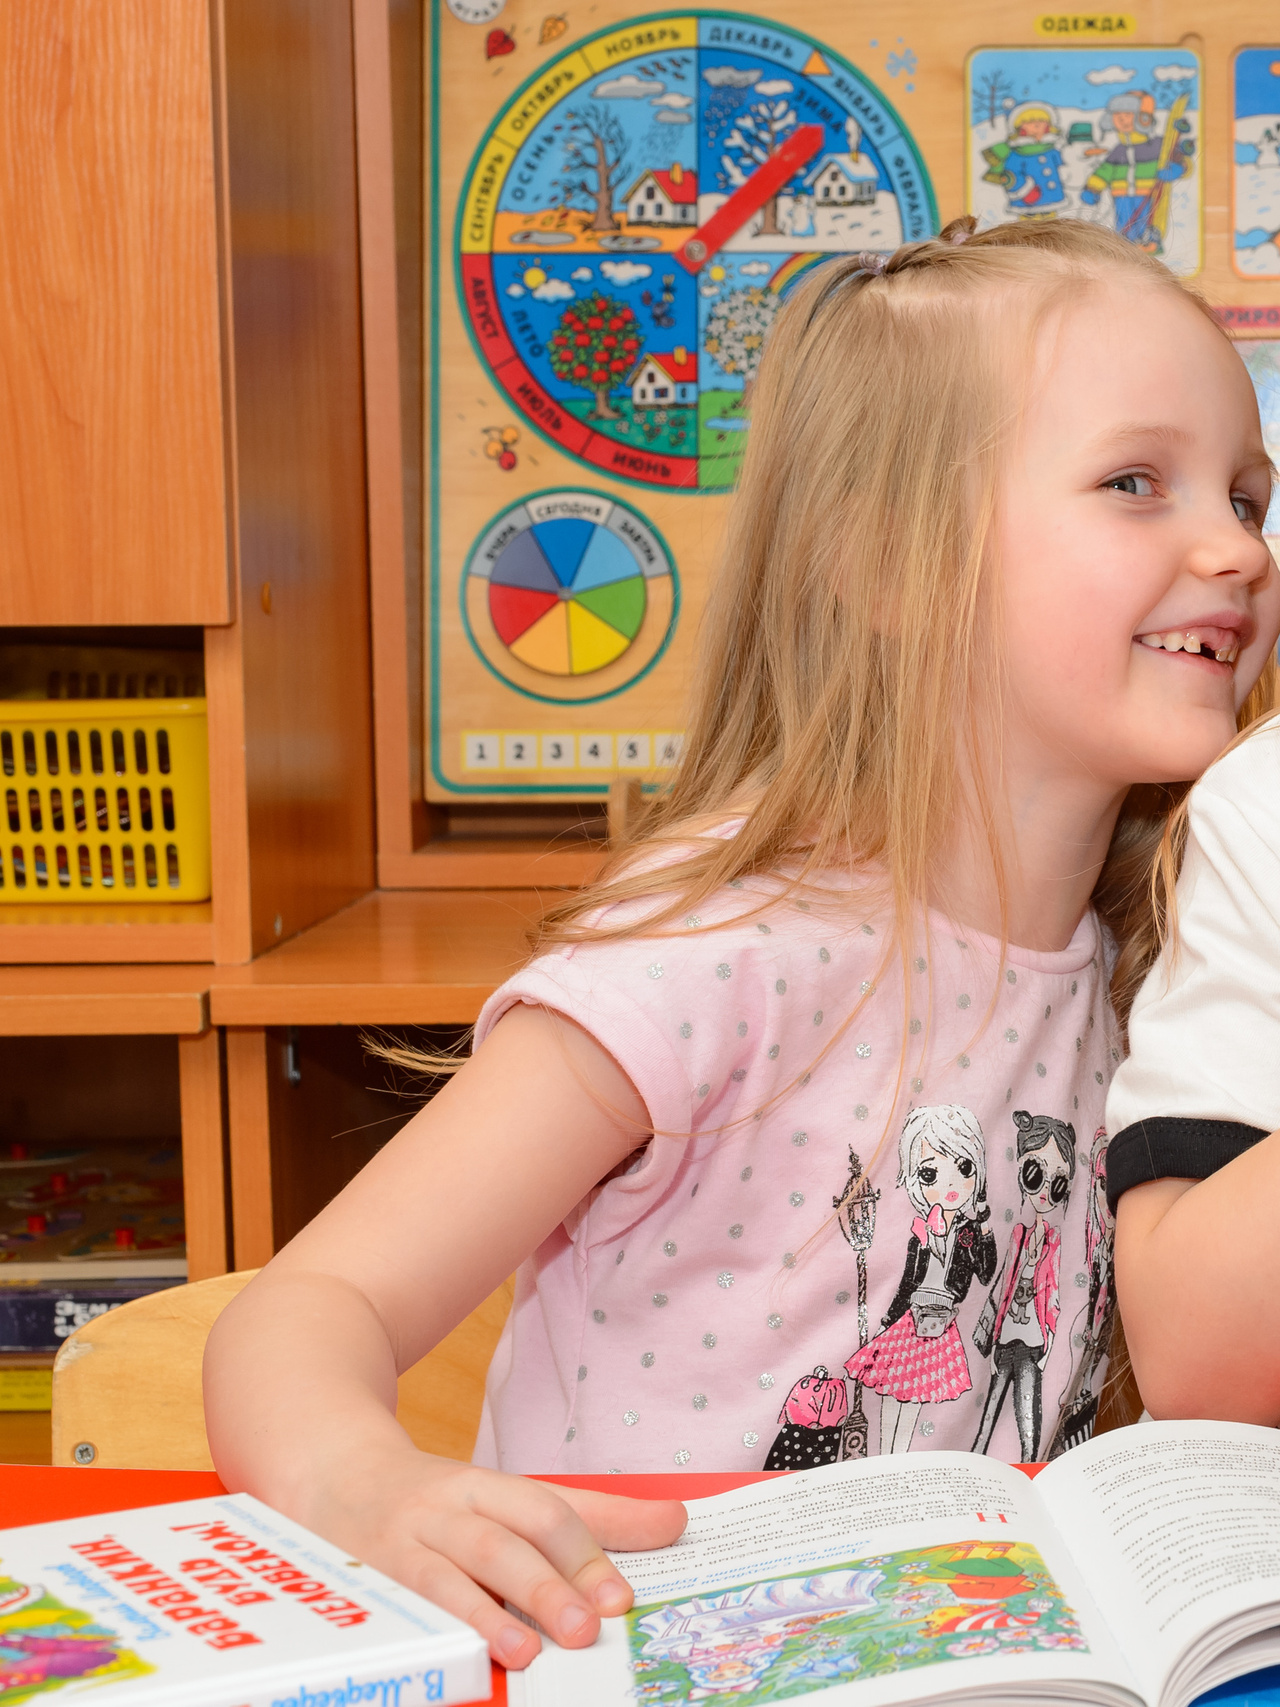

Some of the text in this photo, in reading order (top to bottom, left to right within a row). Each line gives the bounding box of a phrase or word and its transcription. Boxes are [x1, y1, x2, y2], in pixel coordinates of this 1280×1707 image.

[606, 28, 682, 58] НОЯБРЬ
[709, 26, 794, 60] ДЕКАБРЬ
[1042, 17, 1128, 32] ОДЕЖДА
[511, 69, 575, 132] ОКТЯБРЬ
[796, 87, 845, 134] ЗИМА
[833, 76, 886, 136] ЯНВАРЬ
[511, 134, 554, 201] ОСЕНЬ
[470, 152, 505, 243] СЕНТЯБРЬ
[471, 277, 498, 340] АВГУСТ
[511, 309, 544, 358] ЛЕТО
[516, 382, 562, 431] ИЮЛЬ
[613, 452, 670, 478] ИЮНЬ
[476, 744, 486, 761] 1
[513, 744, 525, 760] 2
[551, 744, 562, 760] 3
[588, 744, 600, 760] 4
[626, 743, 638, 760] 5
[169, 1520, 373, 1629] ЧЕЛОВЕКОМ!
[179, 1557, 275, 1608] БУДЬ
[414, 1667, 445, 1701] В.
